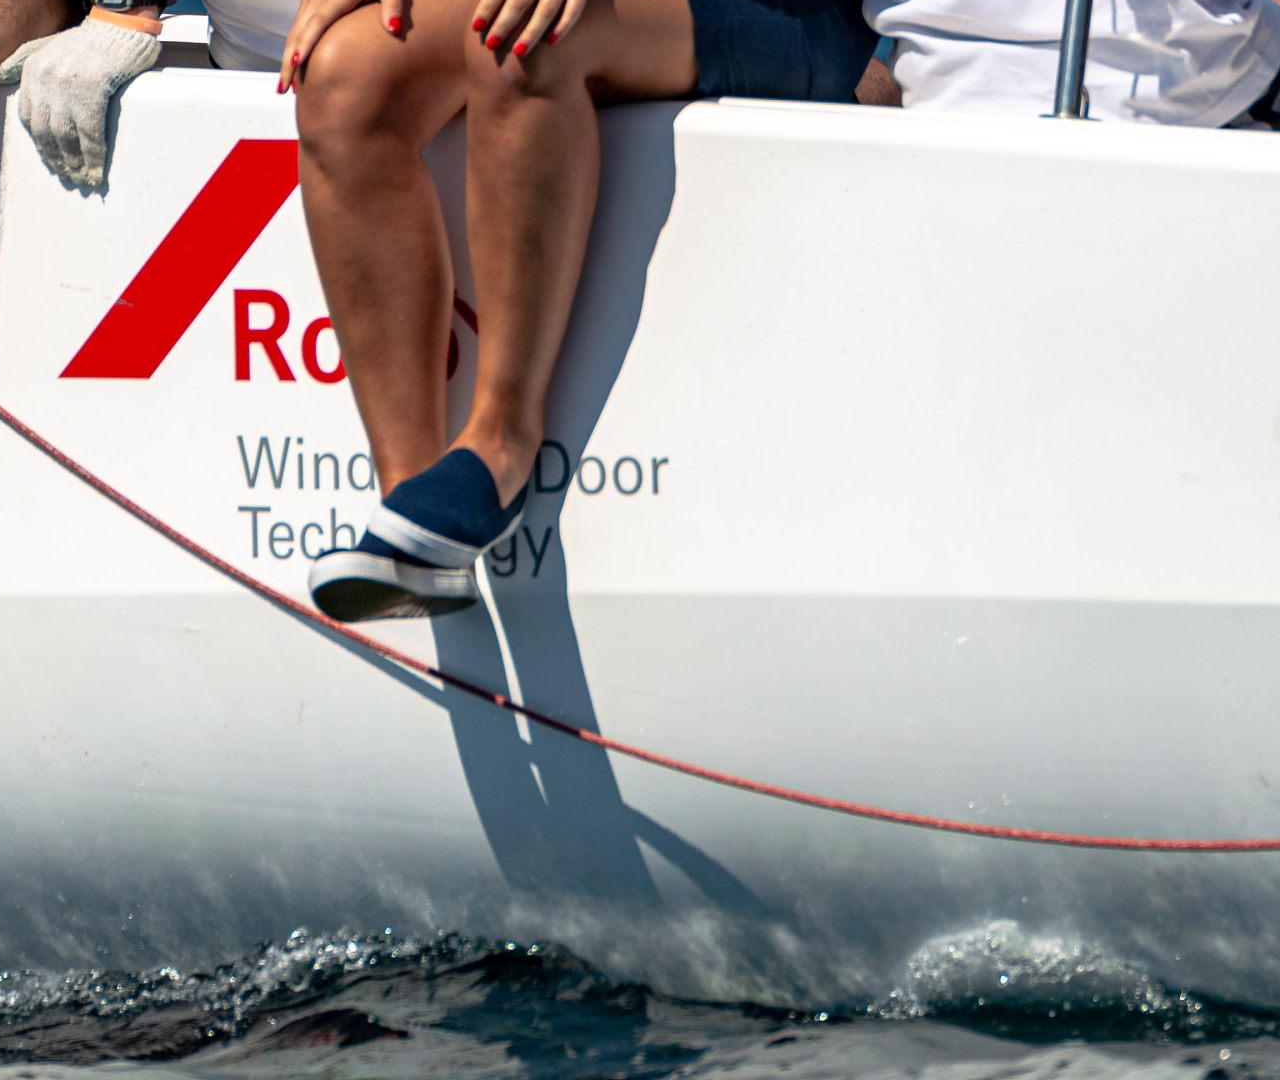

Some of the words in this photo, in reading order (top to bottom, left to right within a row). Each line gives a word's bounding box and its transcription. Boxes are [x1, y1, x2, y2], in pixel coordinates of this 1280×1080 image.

[236, 435, 376, 491] Wind
[534, 439, 670, 496] Door
[237, 505, 553, 578] Techgy
